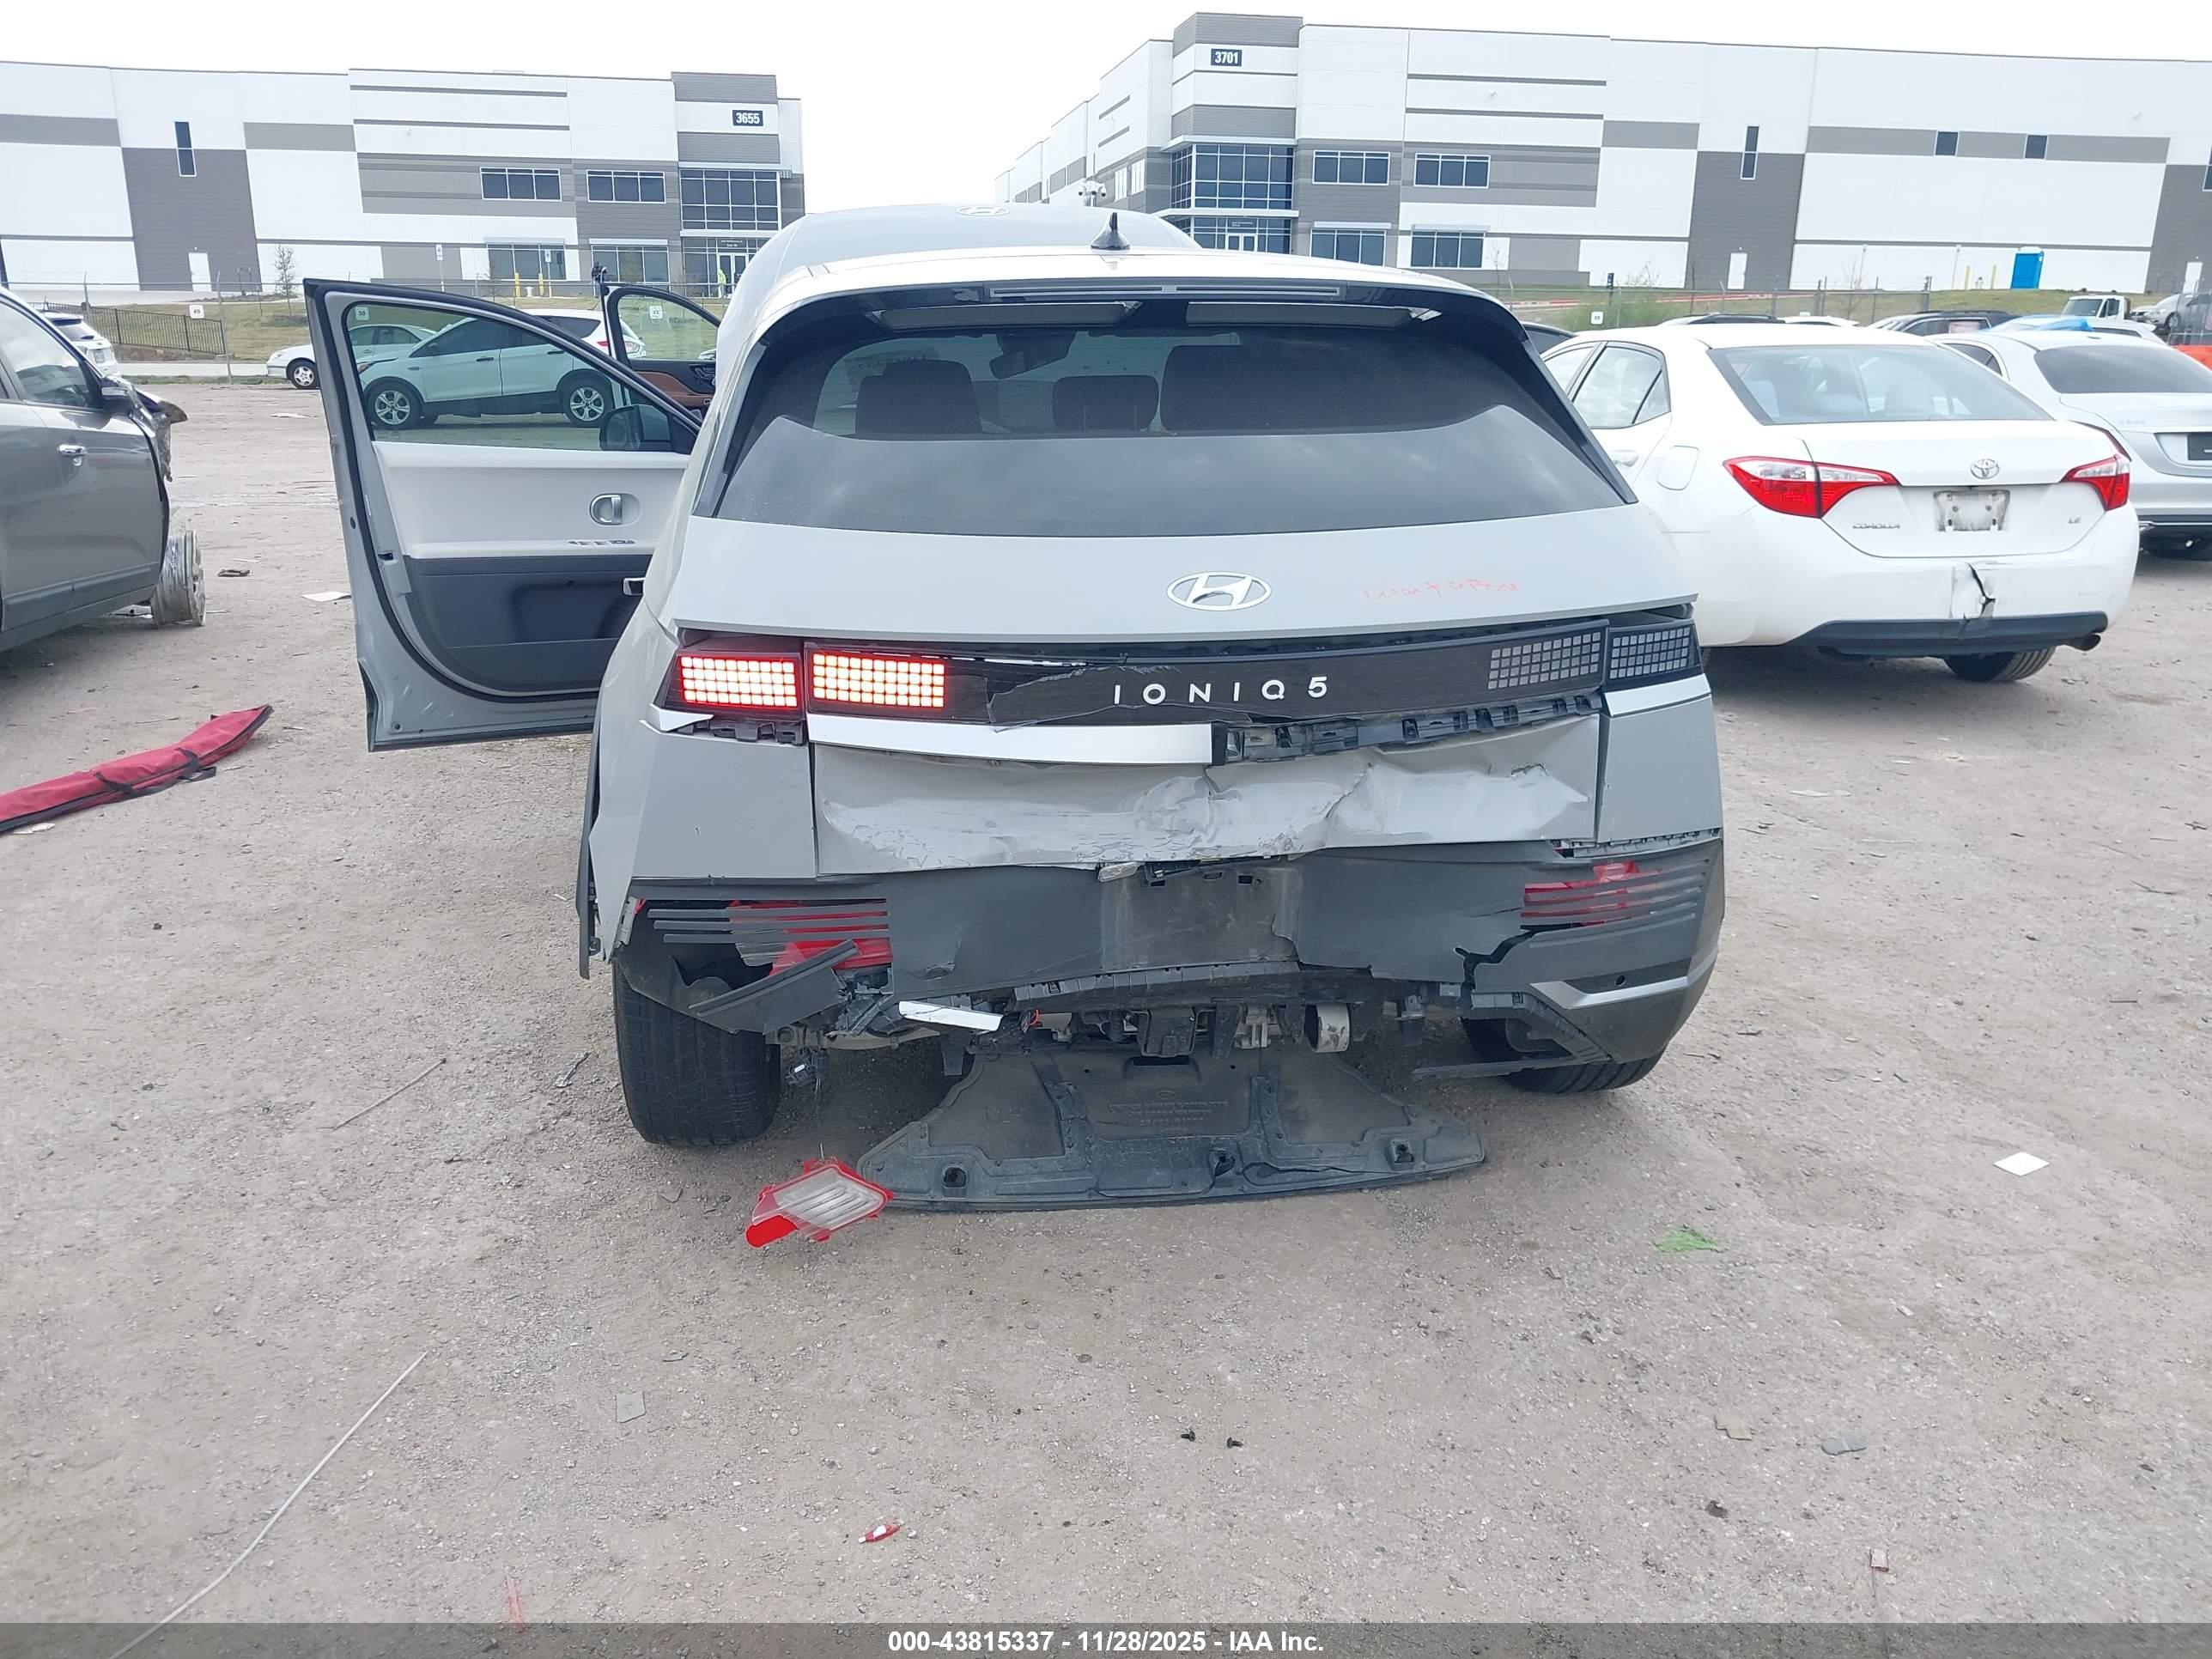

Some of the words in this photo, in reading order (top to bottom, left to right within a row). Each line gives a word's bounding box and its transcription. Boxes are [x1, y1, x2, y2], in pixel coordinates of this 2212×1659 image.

[1214, 51, 1238, 64] 3701
[736, 112, 760, 125] 3655
[1114, 679, 1285, 705] IONIQ
[1308, 676, 1328, 698] 5
